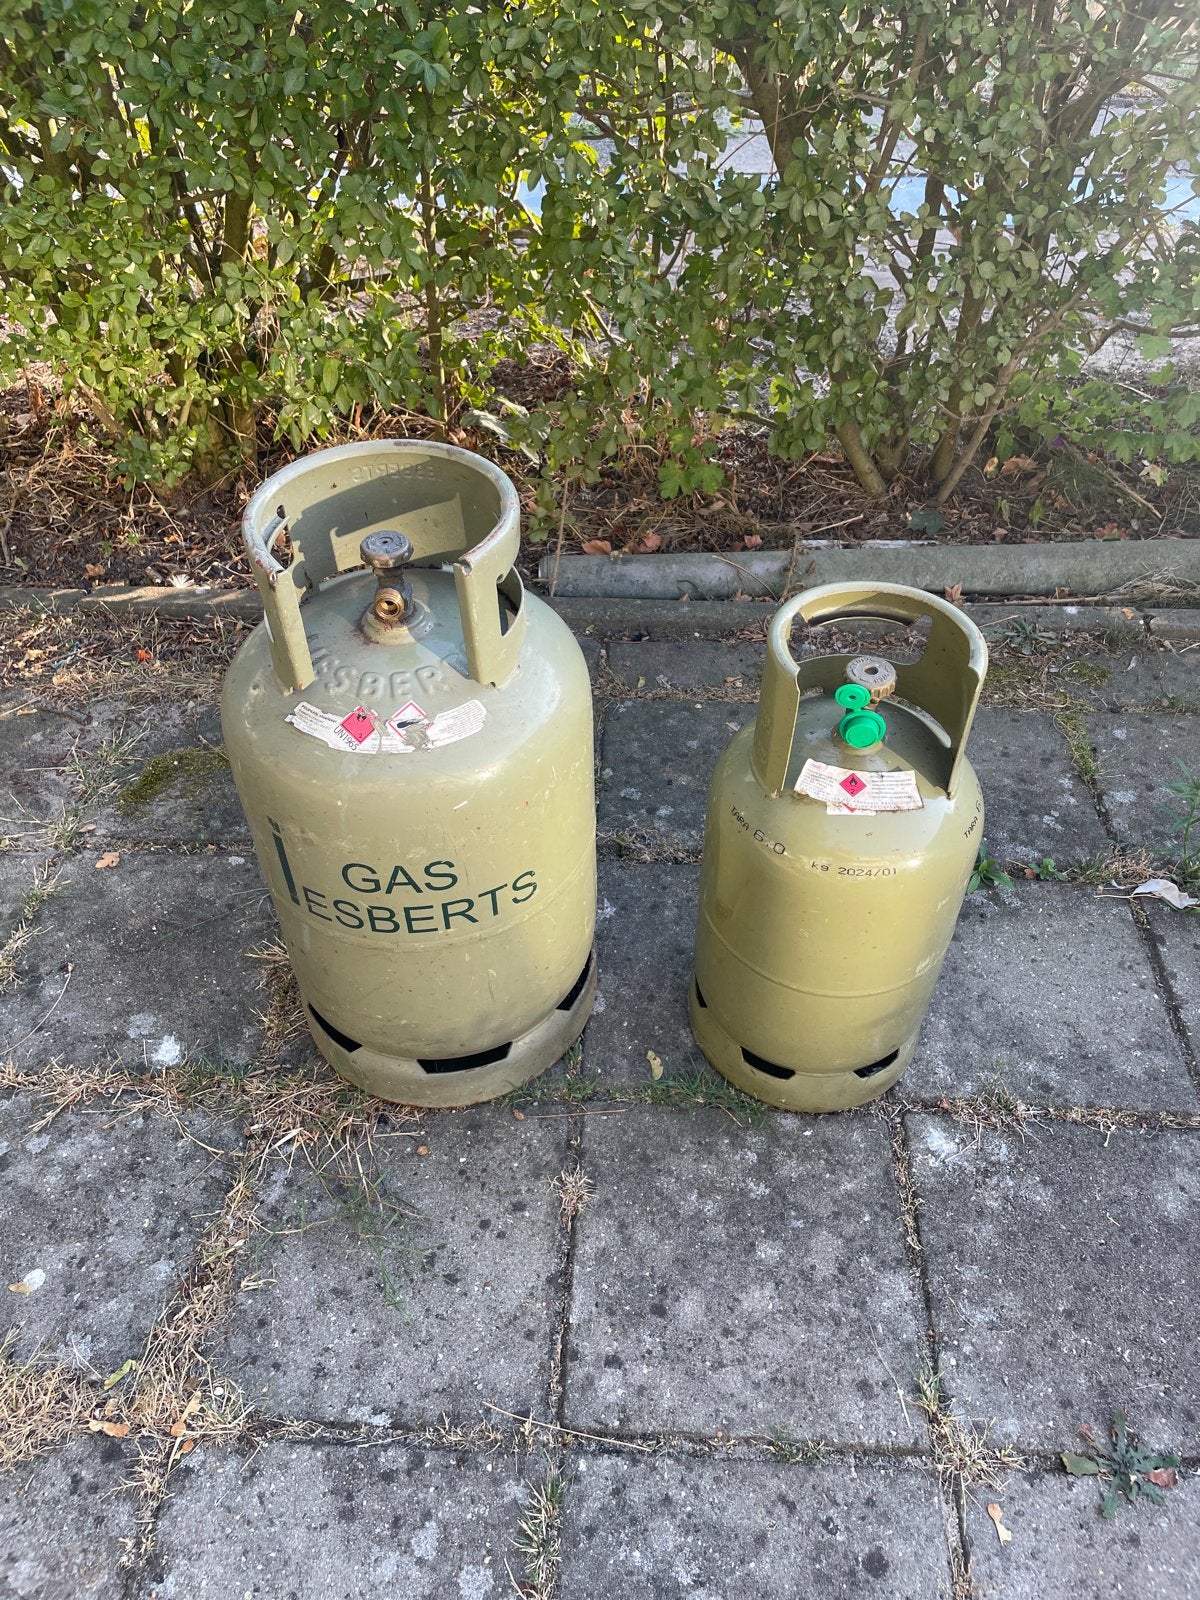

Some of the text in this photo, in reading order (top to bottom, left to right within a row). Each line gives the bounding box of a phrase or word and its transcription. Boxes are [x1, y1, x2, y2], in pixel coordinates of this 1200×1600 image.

[333, 726, 360, 751] UN1965
[730, 804, 750, 831] TARA
[811, 861, 830, 872] kg
[837, 866, 898, 877] 2024/01
[302, 870, 538, 934] ESBERTS
[341, 860, 459, 895] GAS
